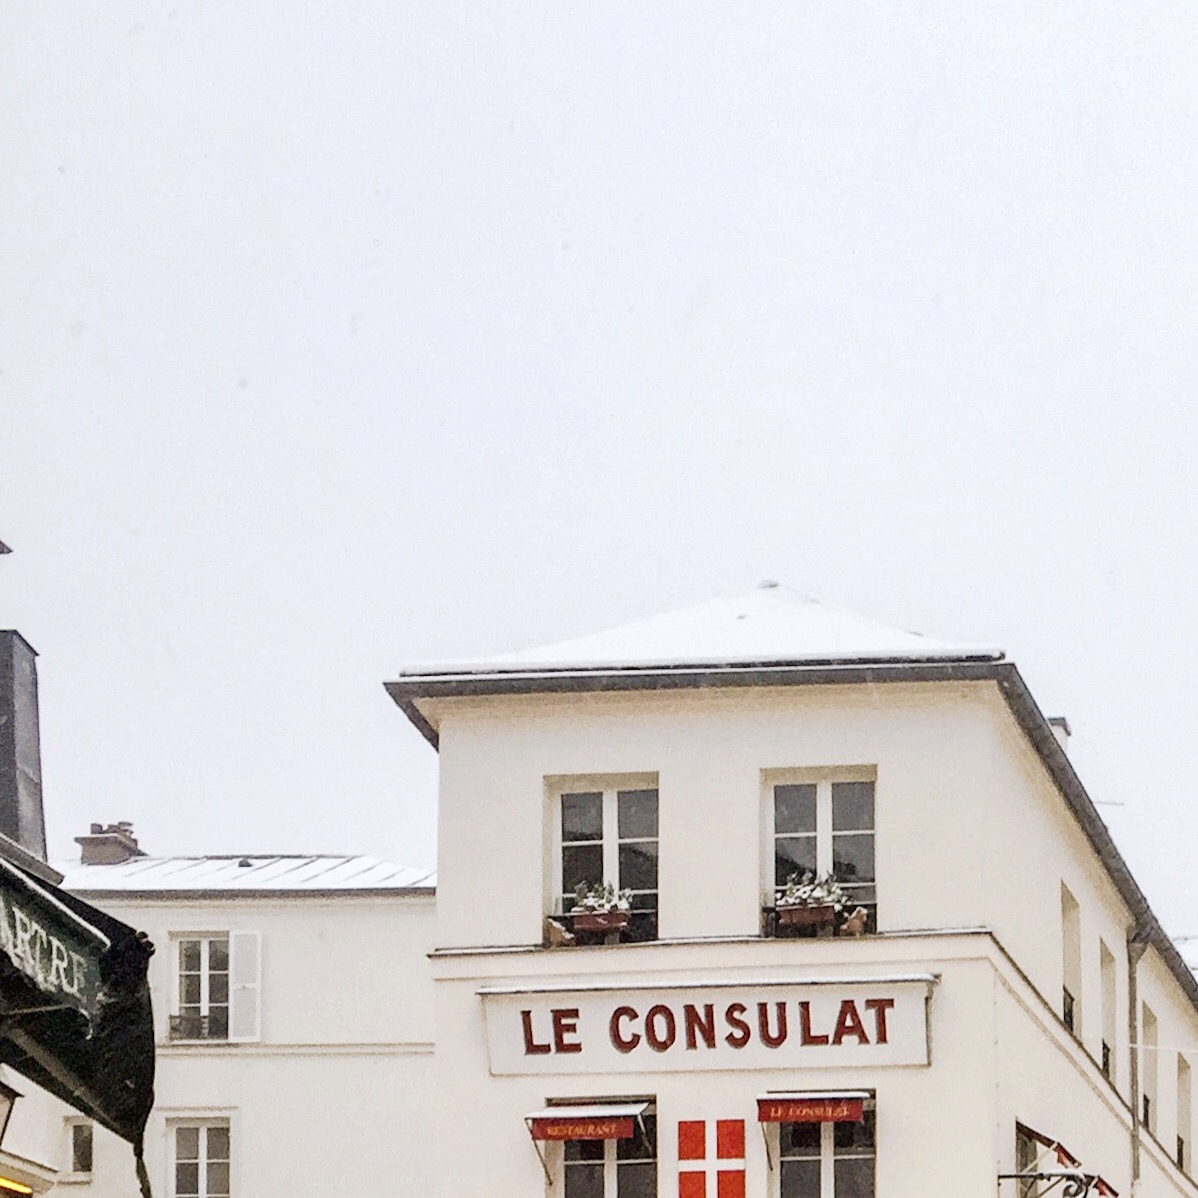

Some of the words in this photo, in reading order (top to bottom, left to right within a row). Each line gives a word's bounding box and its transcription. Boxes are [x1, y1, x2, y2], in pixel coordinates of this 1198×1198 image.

[520, 1008, 582, 1056] LE
[609, 998, 894, 1055] CONSULAT
[769, 1106, 784, 1118] LE
[547, 1123, 618, 1136] RESTAURANT
